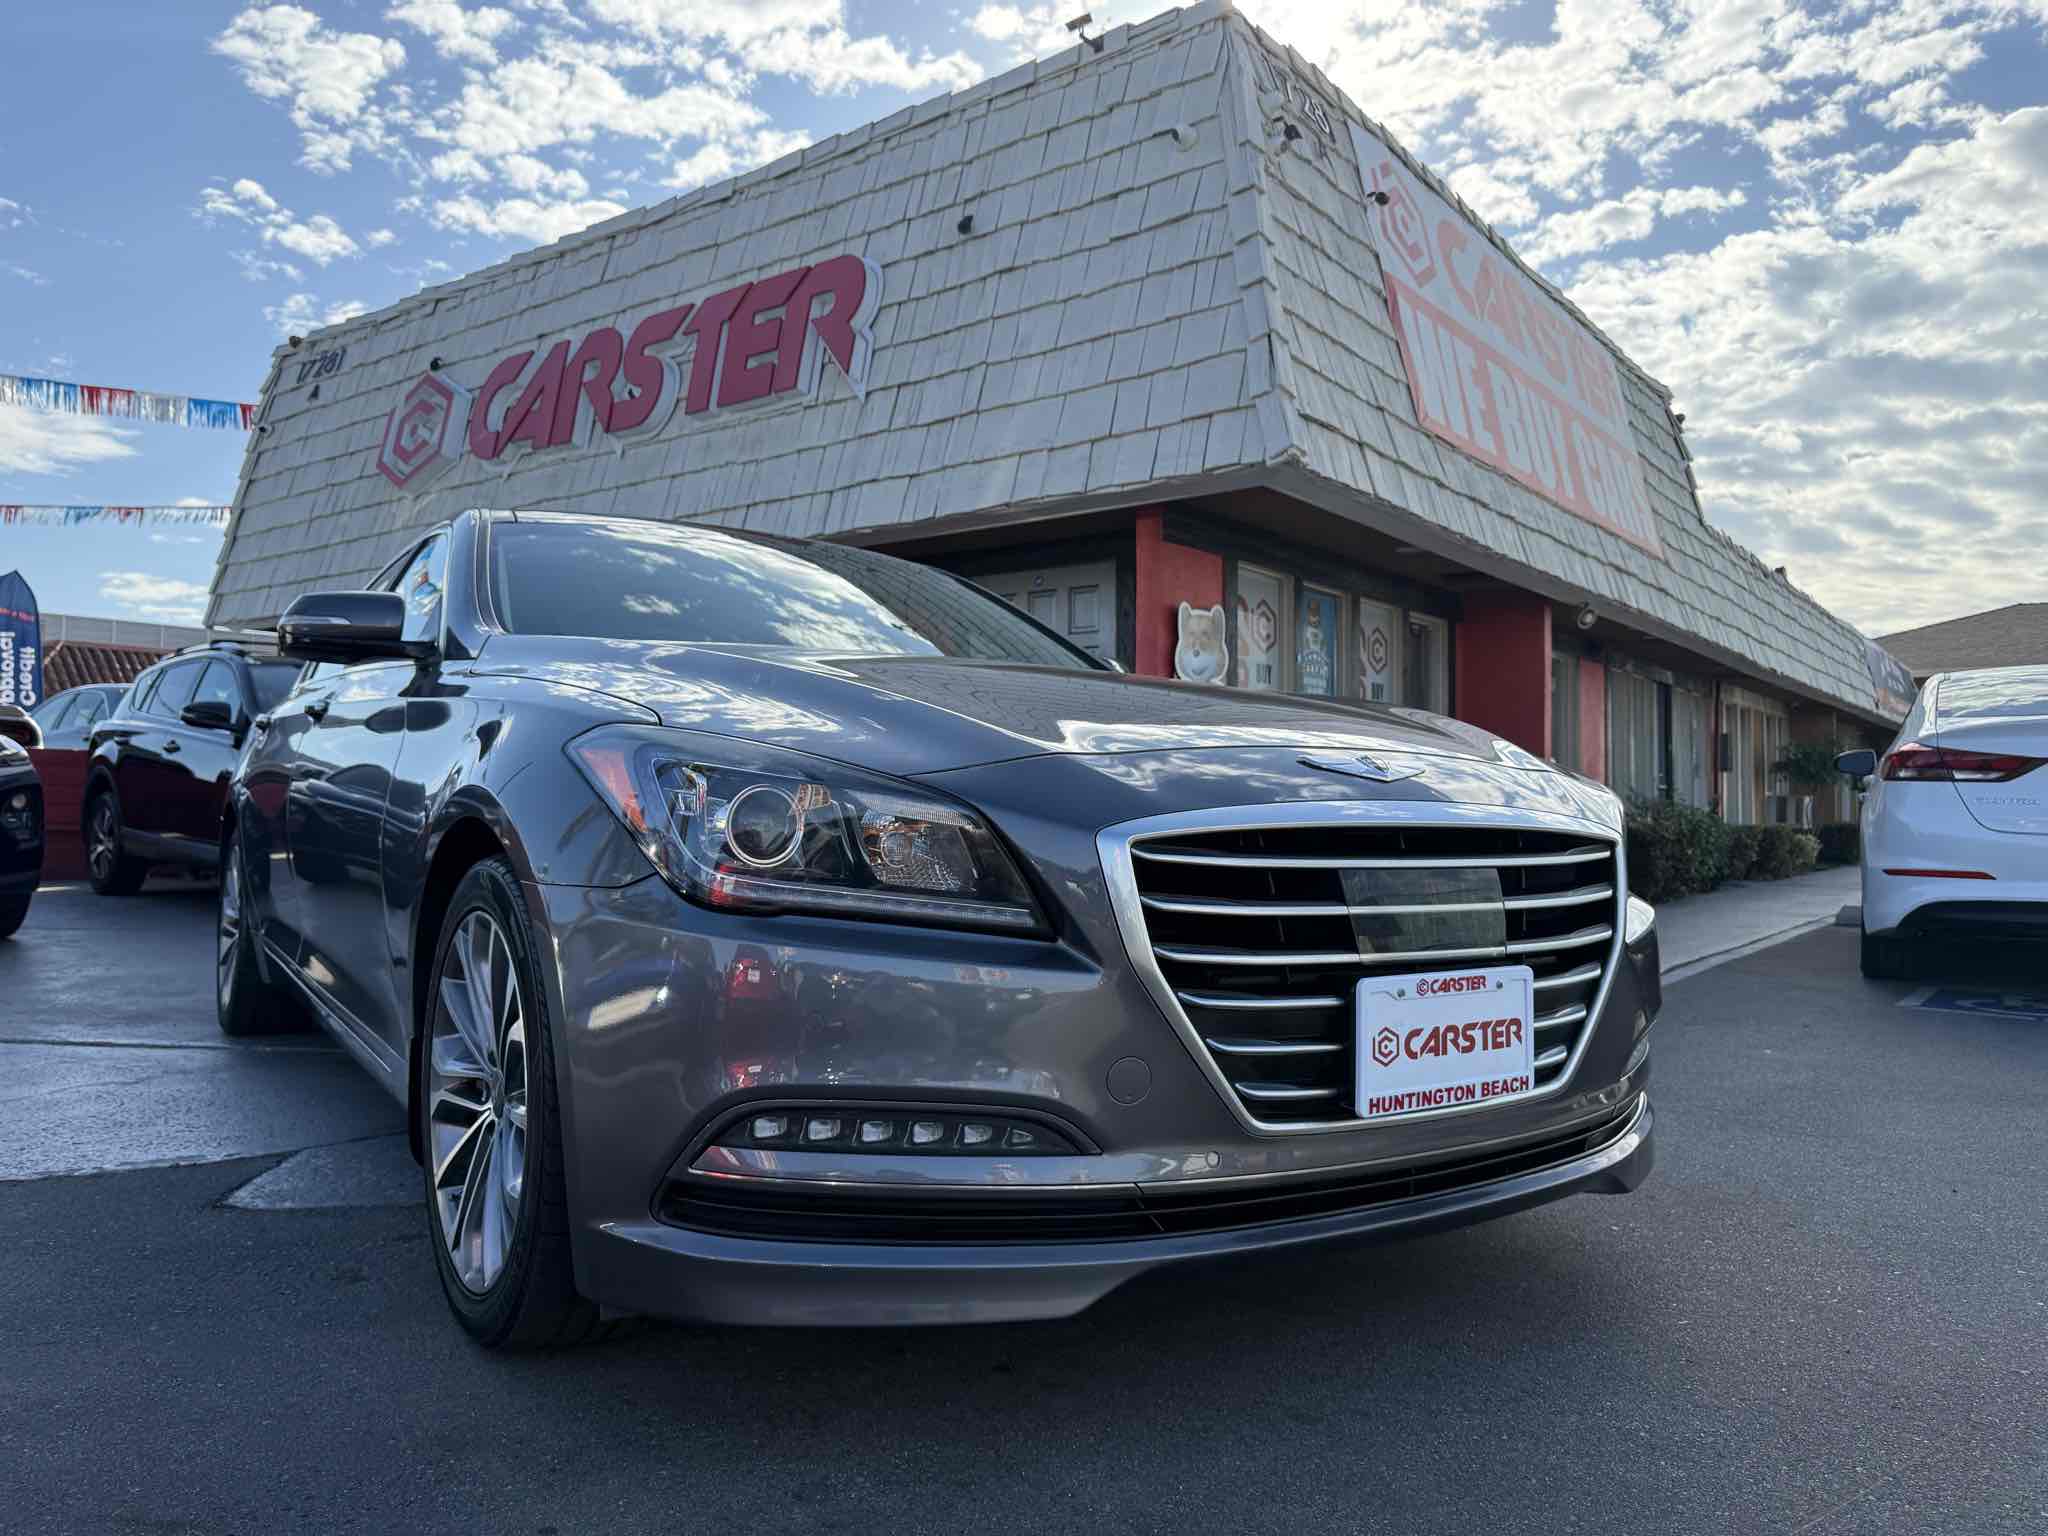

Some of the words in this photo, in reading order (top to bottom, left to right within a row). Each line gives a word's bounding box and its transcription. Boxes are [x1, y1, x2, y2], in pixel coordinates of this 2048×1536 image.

[469, 254, 876, 461] CARSTER
[1437, 218, 1628, 431] CARSTER
[1398, 294, 1500, 457] WE
[1488, 359, 1577, 502] BUY
[1404, 1017, 1523, 1060] CARSTER
[1430, 975, 1487, 994] CARSTER
[1369, 1082, 1476, 1115] HUNTINGTON
[1481, 1075, 1530, 1098] BEACH
